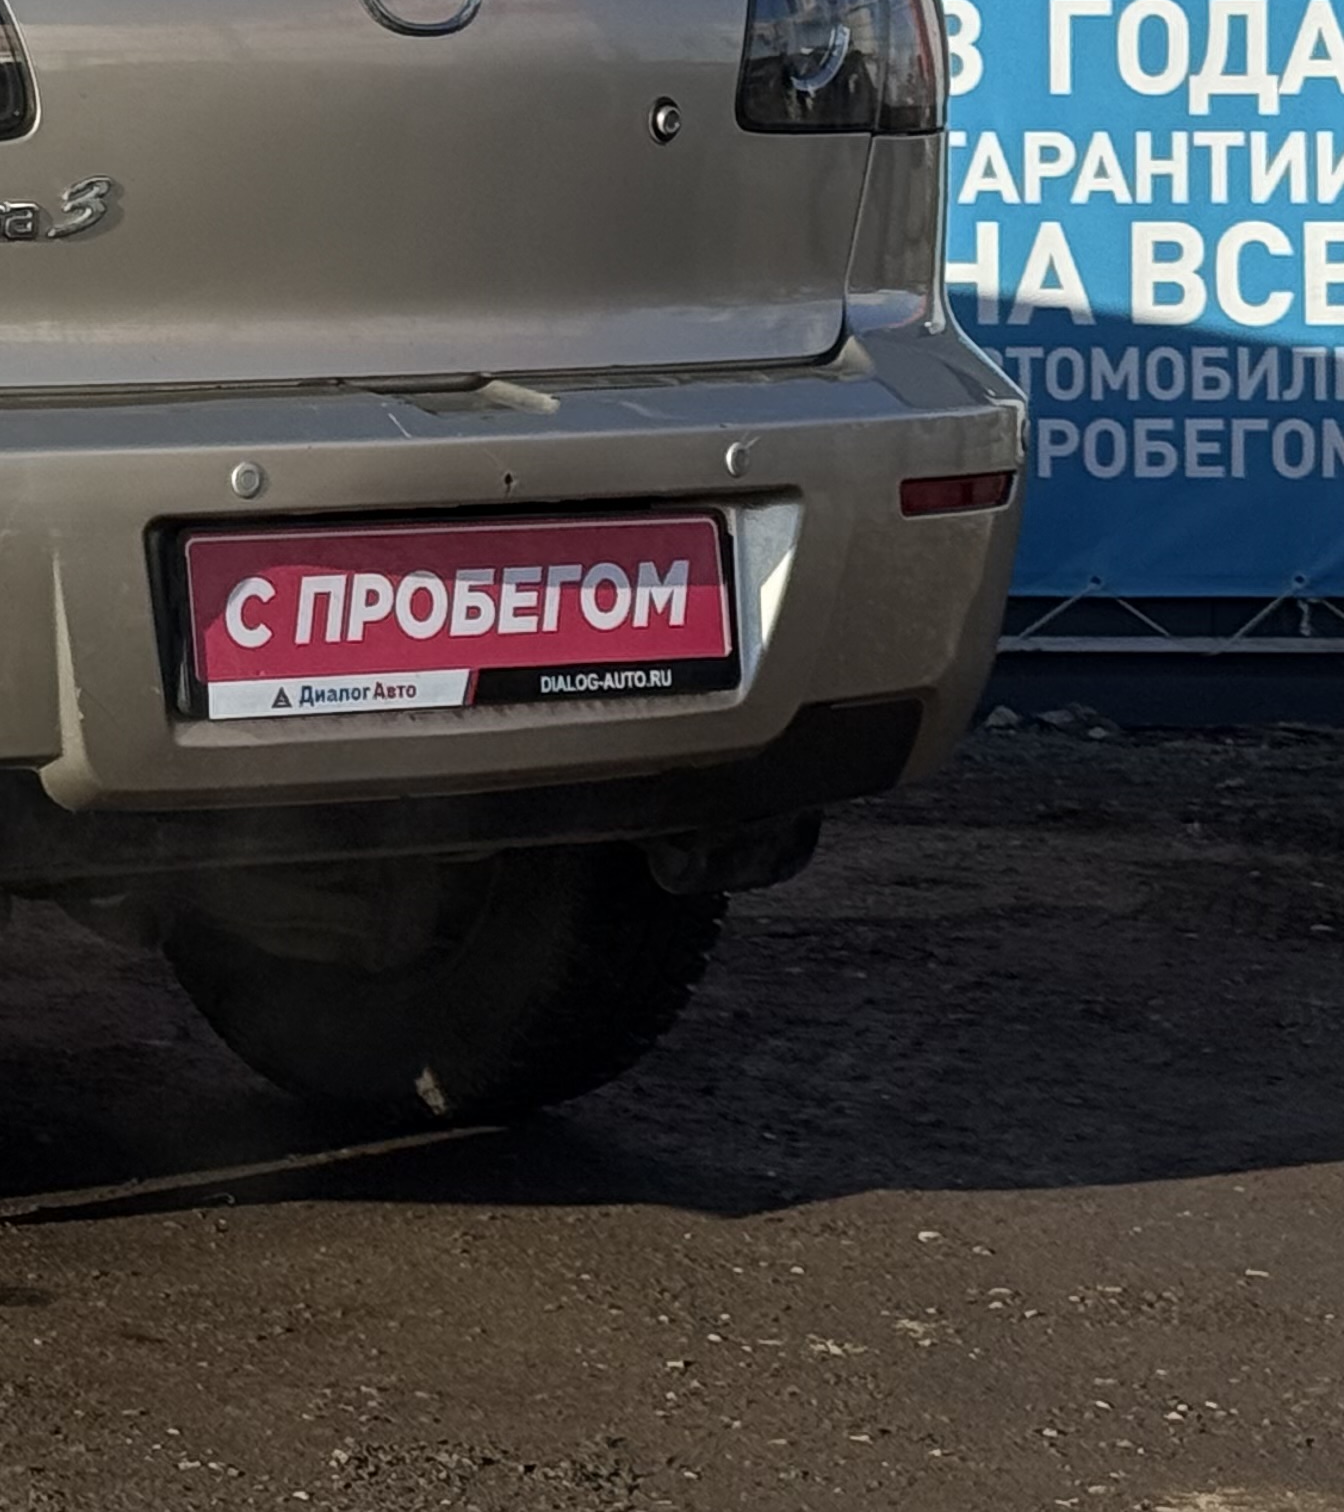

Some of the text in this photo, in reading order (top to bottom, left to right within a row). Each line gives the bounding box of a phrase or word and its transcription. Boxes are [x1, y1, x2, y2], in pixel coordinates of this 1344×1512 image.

[48, 174, 112, 238] 3
[1131, 220, 1344, 327] ВСЕ
[1036, 418, 1344, 479] РОБЕГО
[224, 559, 690, 648] С ПРОБЕГОМ
[540, 668, 673, 694] DIALOG-AUTO.RU
